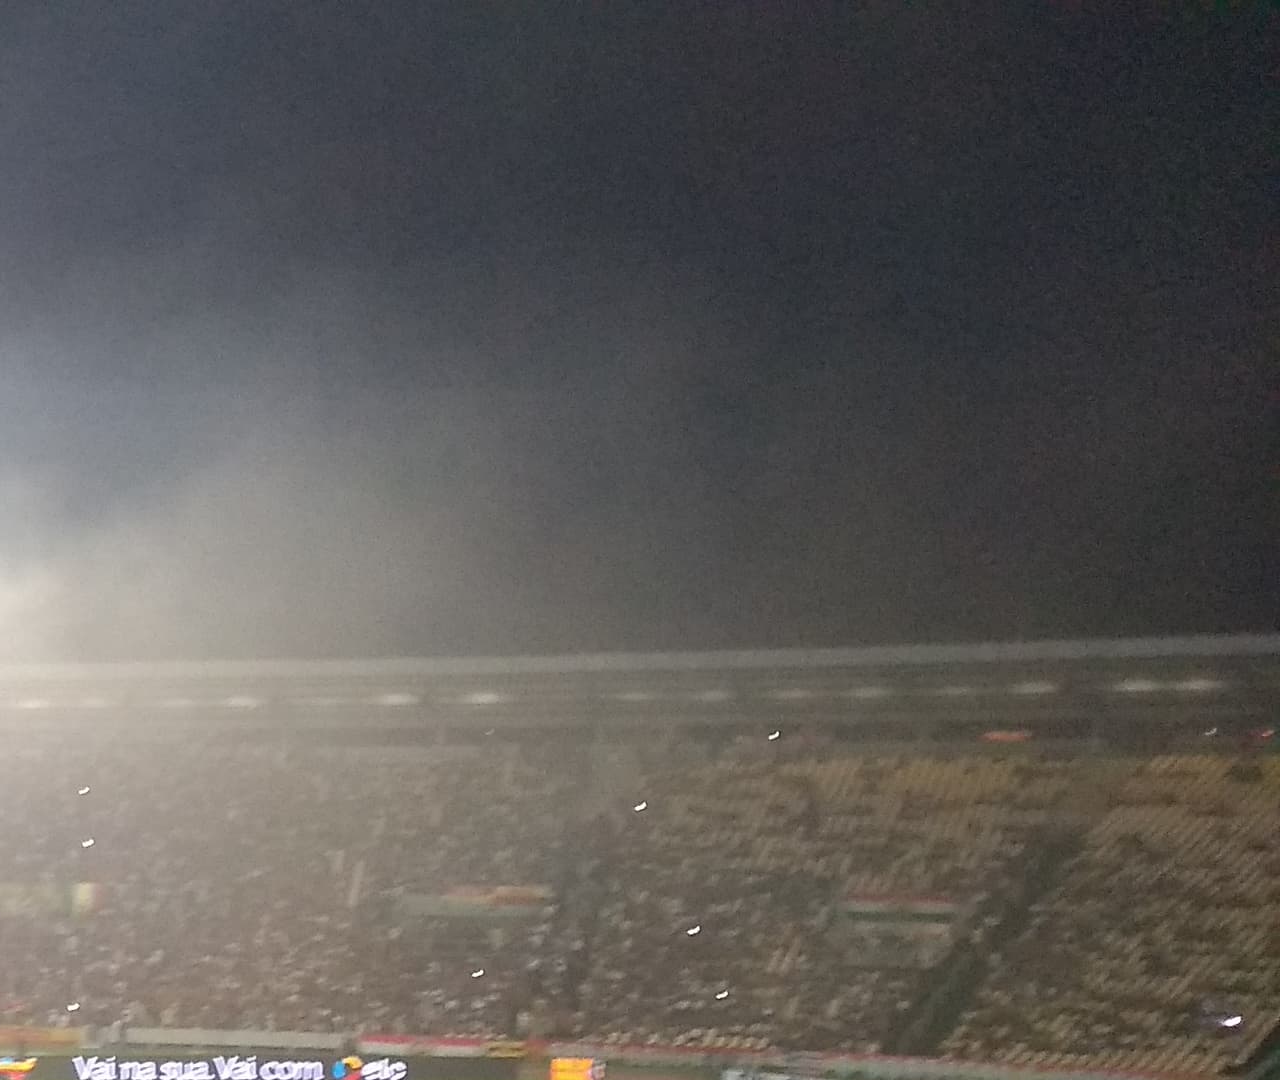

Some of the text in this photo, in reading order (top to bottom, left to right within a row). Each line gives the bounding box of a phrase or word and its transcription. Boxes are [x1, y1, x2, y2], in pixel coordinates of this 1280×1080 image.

[72, 1056, 117, 1080] Vai
[119, 1060, 156, 1080] na
[213, 1056, 258, 1080] Vai
[259, 1060, 325, 1080] com
